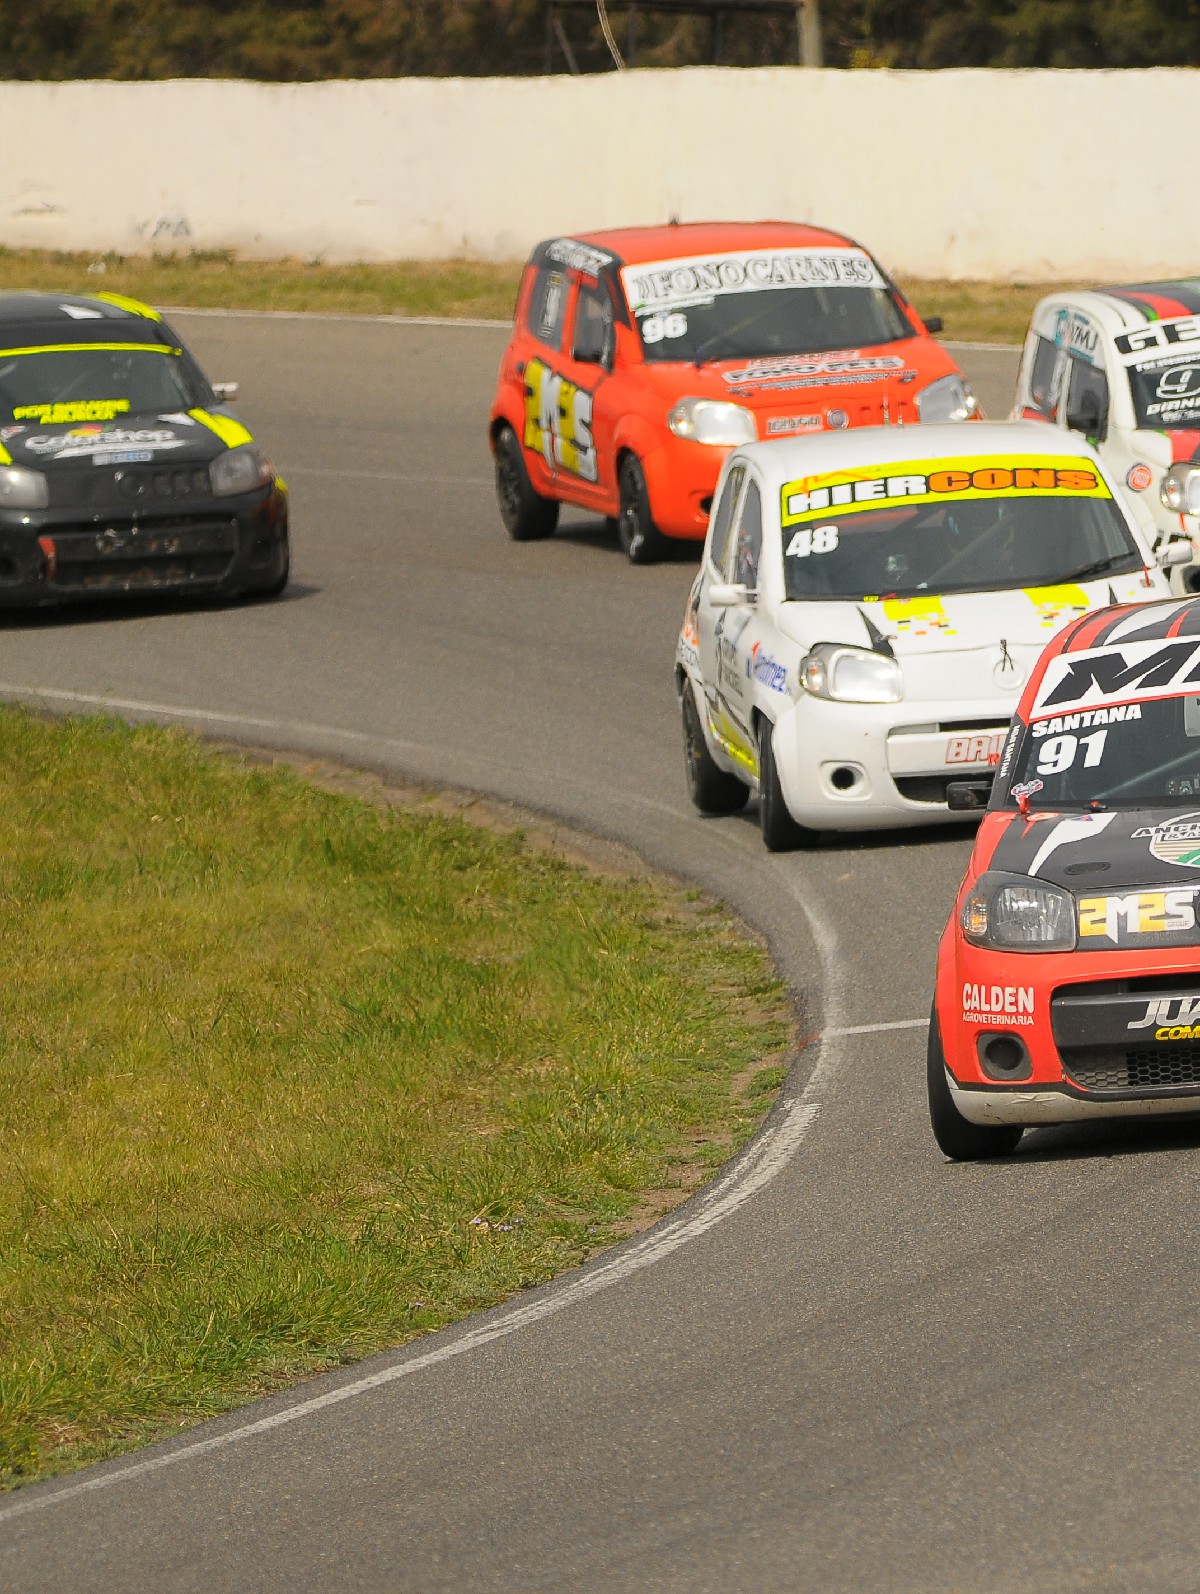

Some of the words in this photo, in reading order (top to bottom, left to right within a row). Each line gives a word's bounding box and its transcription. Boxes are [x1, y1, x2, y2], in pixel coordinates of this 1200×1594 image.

[642, 312, 688, 344] 96
[787, 467, 1099, 516] HIERCONS
[785, 524, 840, 559] 48
[1032, 704, 1142, 738] SANTANA
[1036, 729, 1108, 776] 91
[962, 982, 1035, 1014] CALDEN
[962, 1011, 1035, 1026] AGROVETERINARIA
